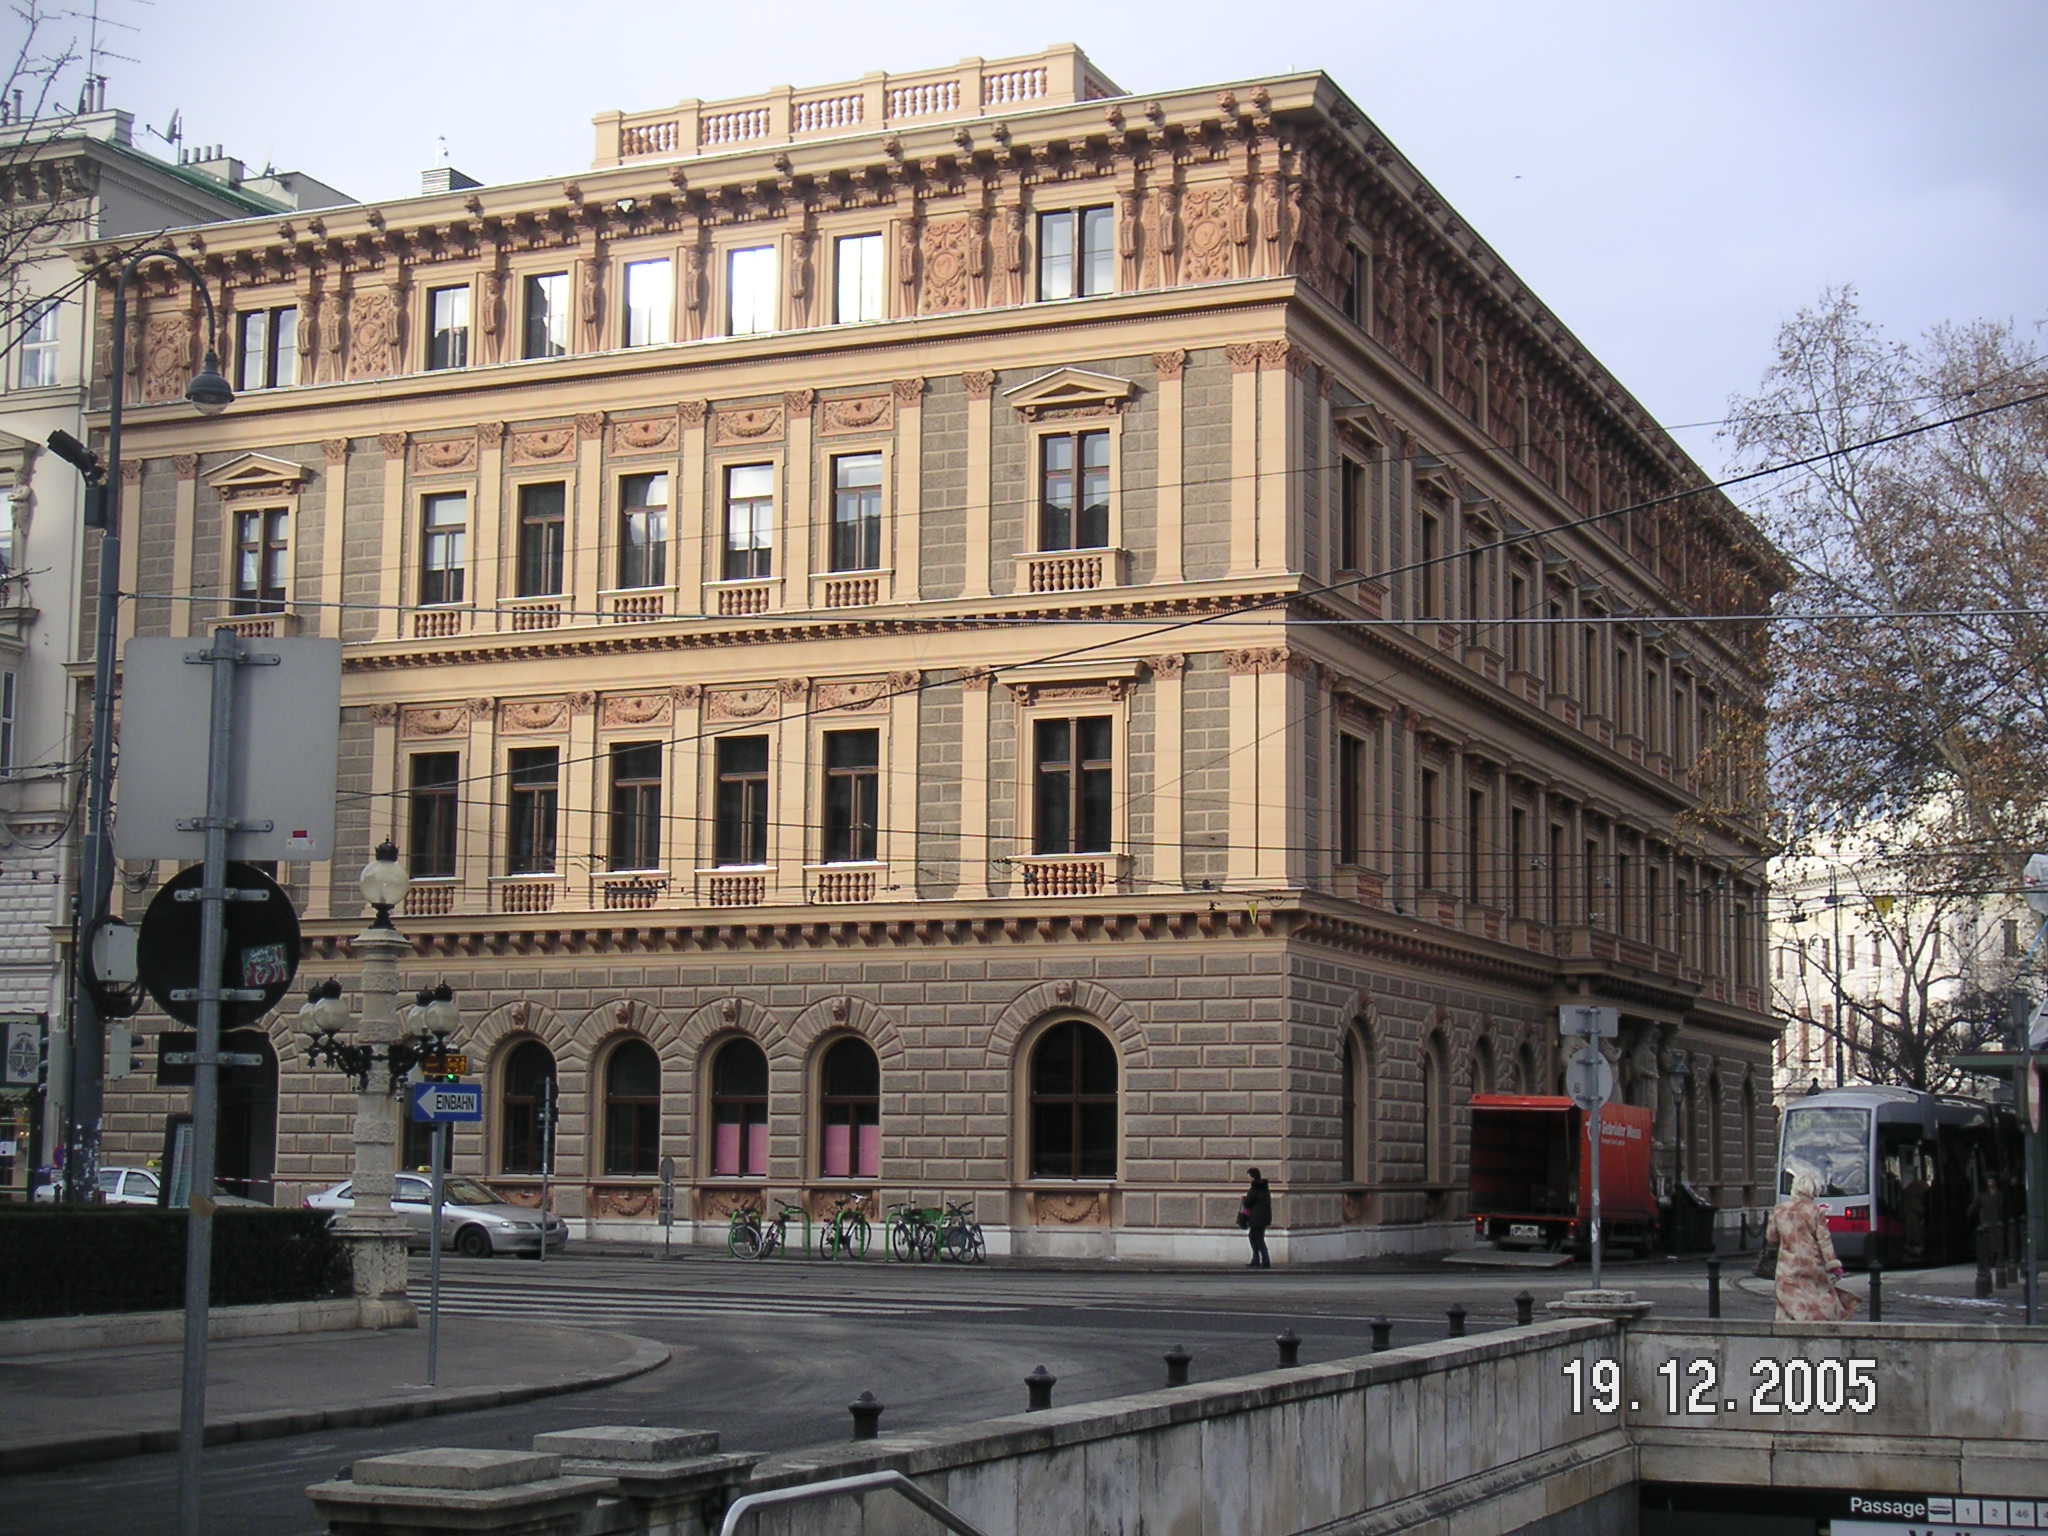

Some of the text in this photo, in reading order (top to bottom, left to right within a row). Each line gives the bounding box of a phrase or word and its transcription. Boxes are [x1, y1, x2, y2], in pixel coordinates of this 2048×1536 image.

[436, 1094, 475, 1110] EINBAHN
[1850, 1497, 1926, 1518] Passage
[1991, 1508, 1999, 1518] 2
